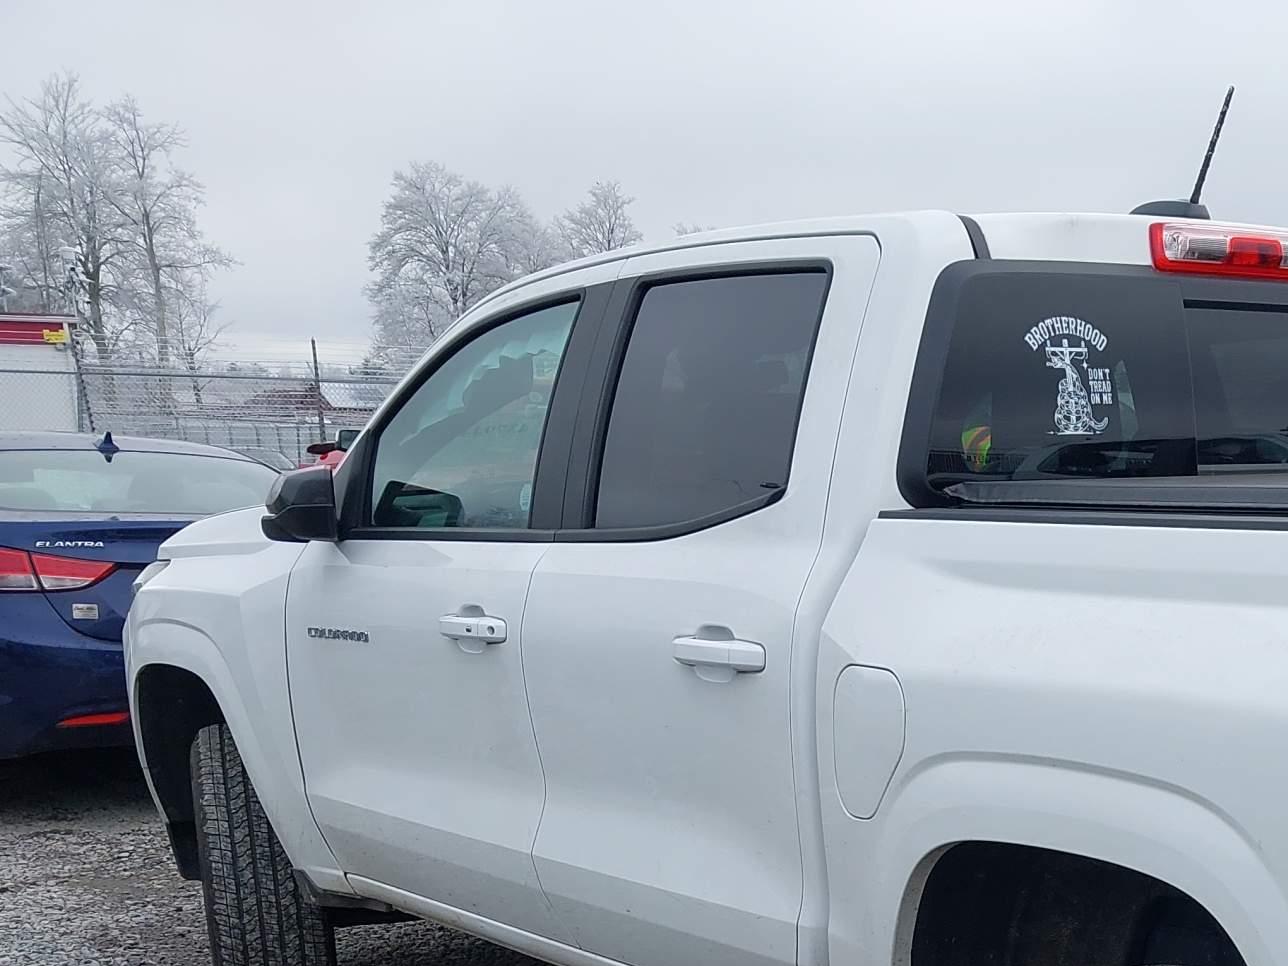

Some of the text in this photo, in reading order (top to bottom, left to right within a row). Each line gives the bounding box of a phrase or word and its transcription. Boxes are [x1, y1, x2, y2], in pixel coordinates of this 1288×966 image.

[1024, 316, 1108, 352] BROTHERHOOD
[1087, 367, 1110, 380] DON'T
[1088, 380, 1112, 392] TREAD
[1090, 392, 1113, 405] ON ME
[35, 540, 105, 548] ELANTRA
